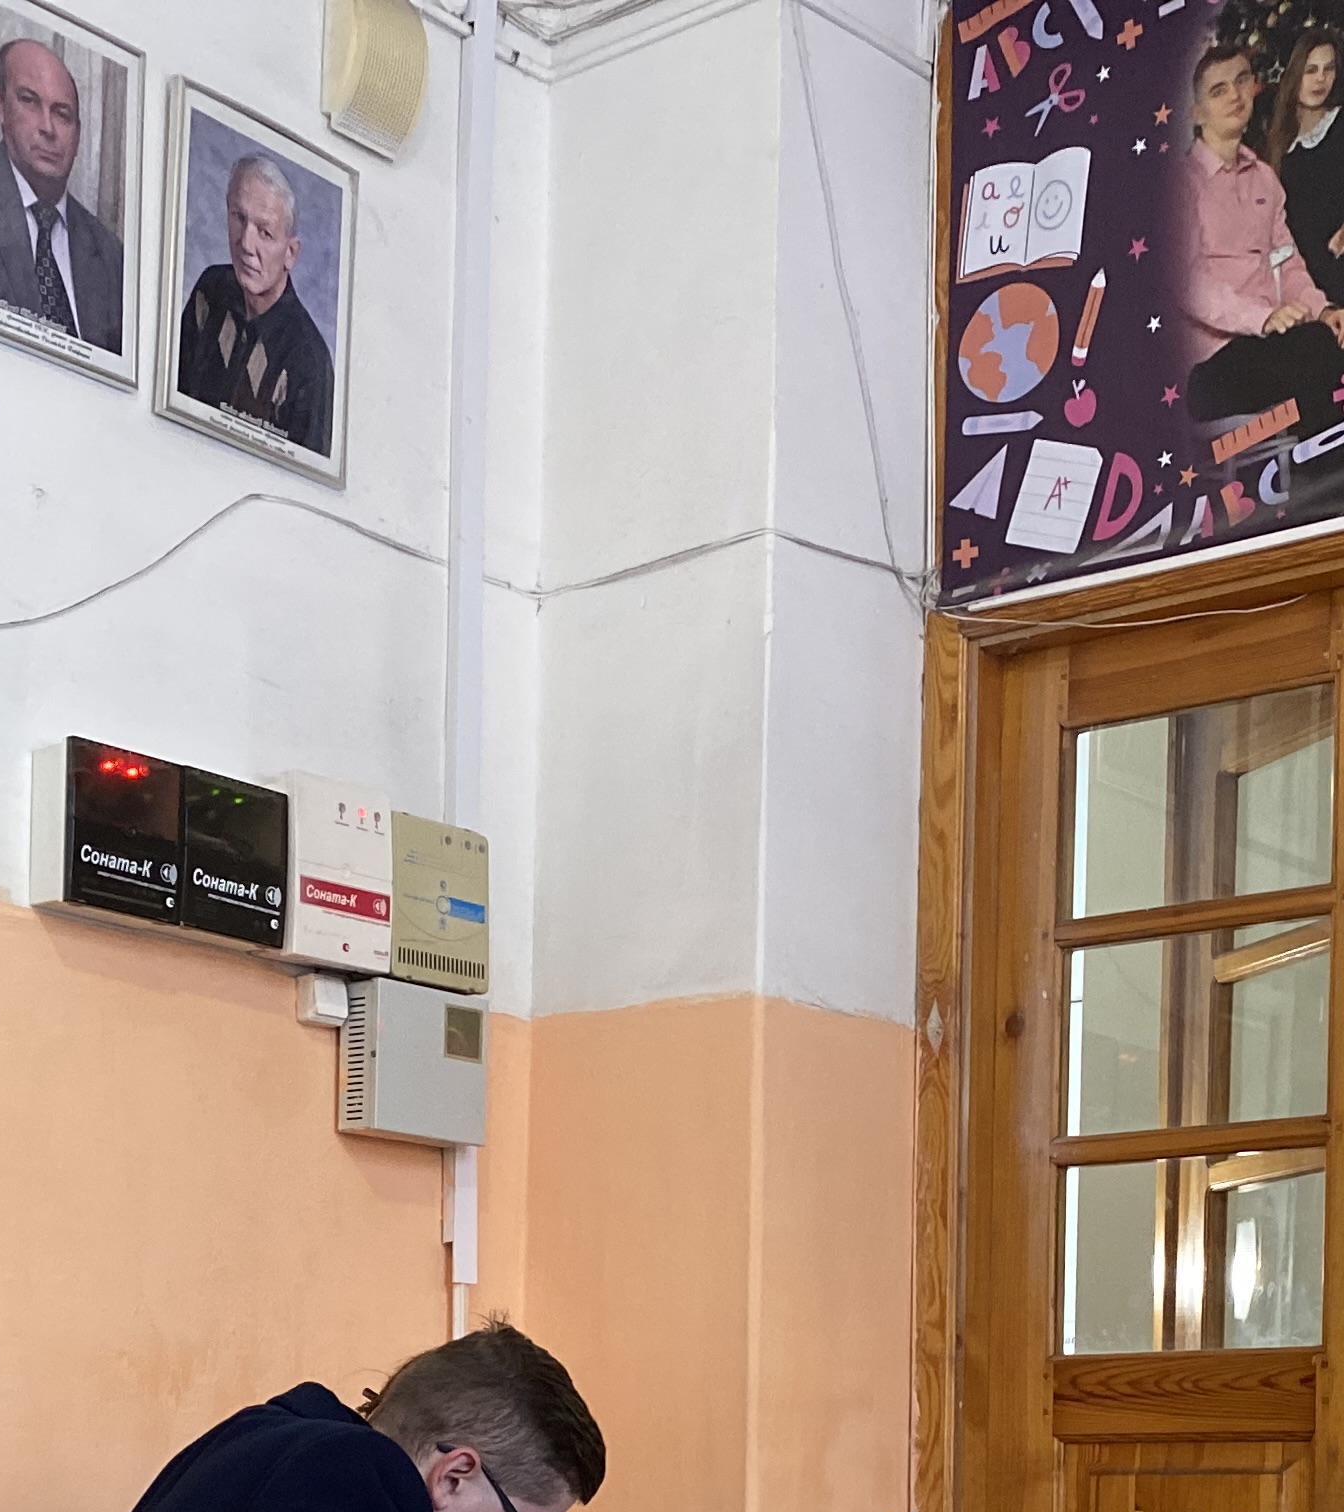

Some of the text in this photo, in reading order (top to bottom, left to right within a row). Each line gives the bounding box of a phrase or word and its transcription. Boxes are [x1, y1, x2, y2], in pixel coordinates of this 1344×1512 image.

[80, 845, 153, 878] Соната-К
[192, 868, 260, 901] Соната-К
[305, 884, 358, 908] Соната-К
